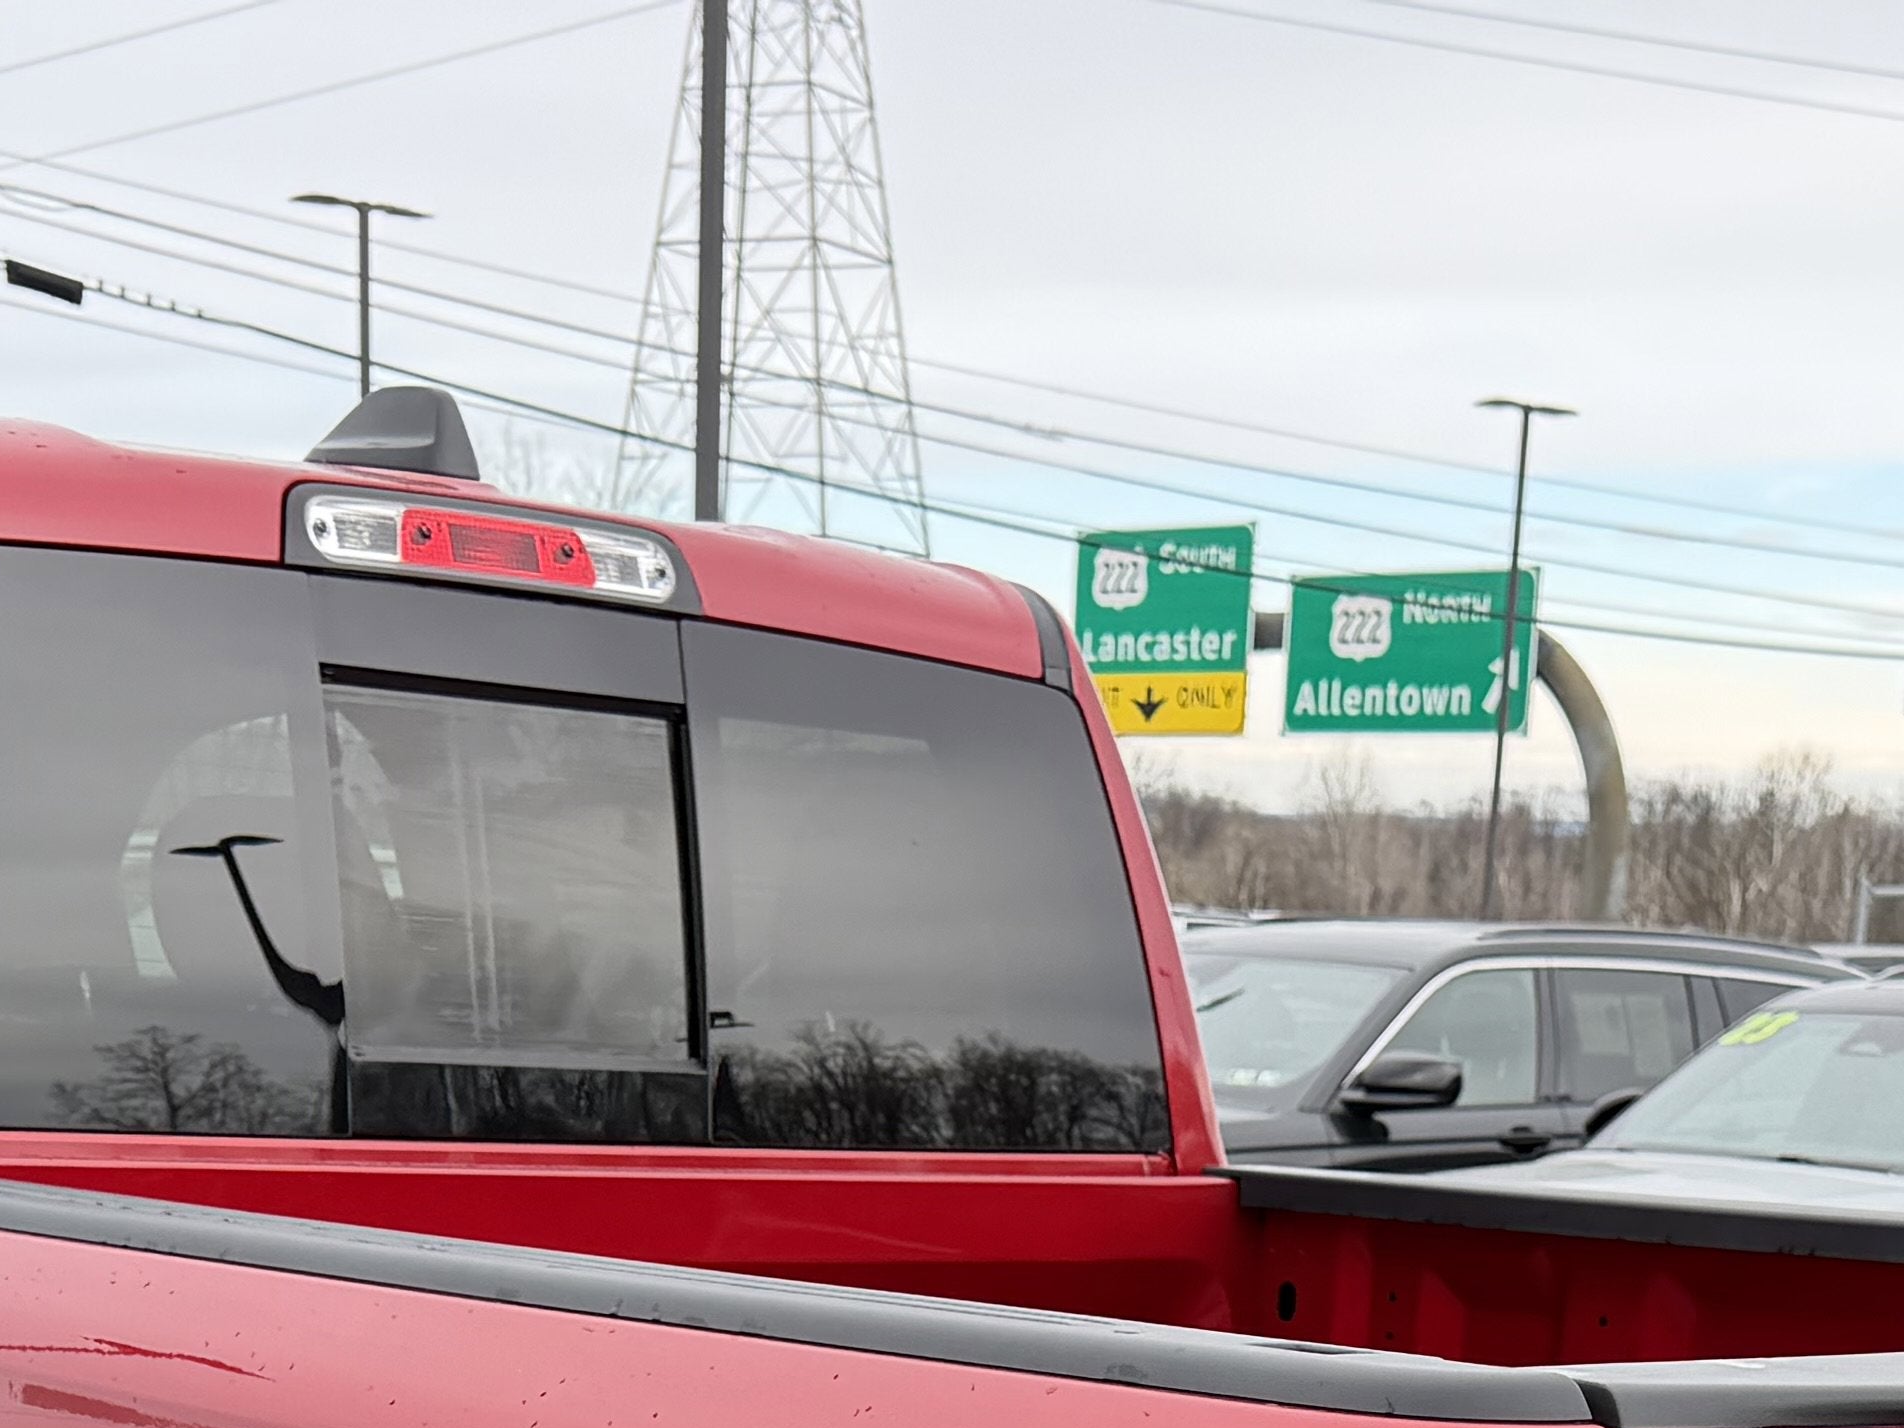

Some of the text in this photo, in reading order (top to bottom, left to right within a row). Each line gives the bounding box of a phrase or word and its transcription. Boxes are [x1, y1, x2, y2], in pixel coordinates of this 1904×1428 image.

[1101, 560, 1139, 595] 222
[1082, 626, 1238, 663] Lancaster
[1337, 609, 1383, 645] 222
[1175, 685, 1238, 710] ONLY
[1292, 677, 1472, 717] Allentown
